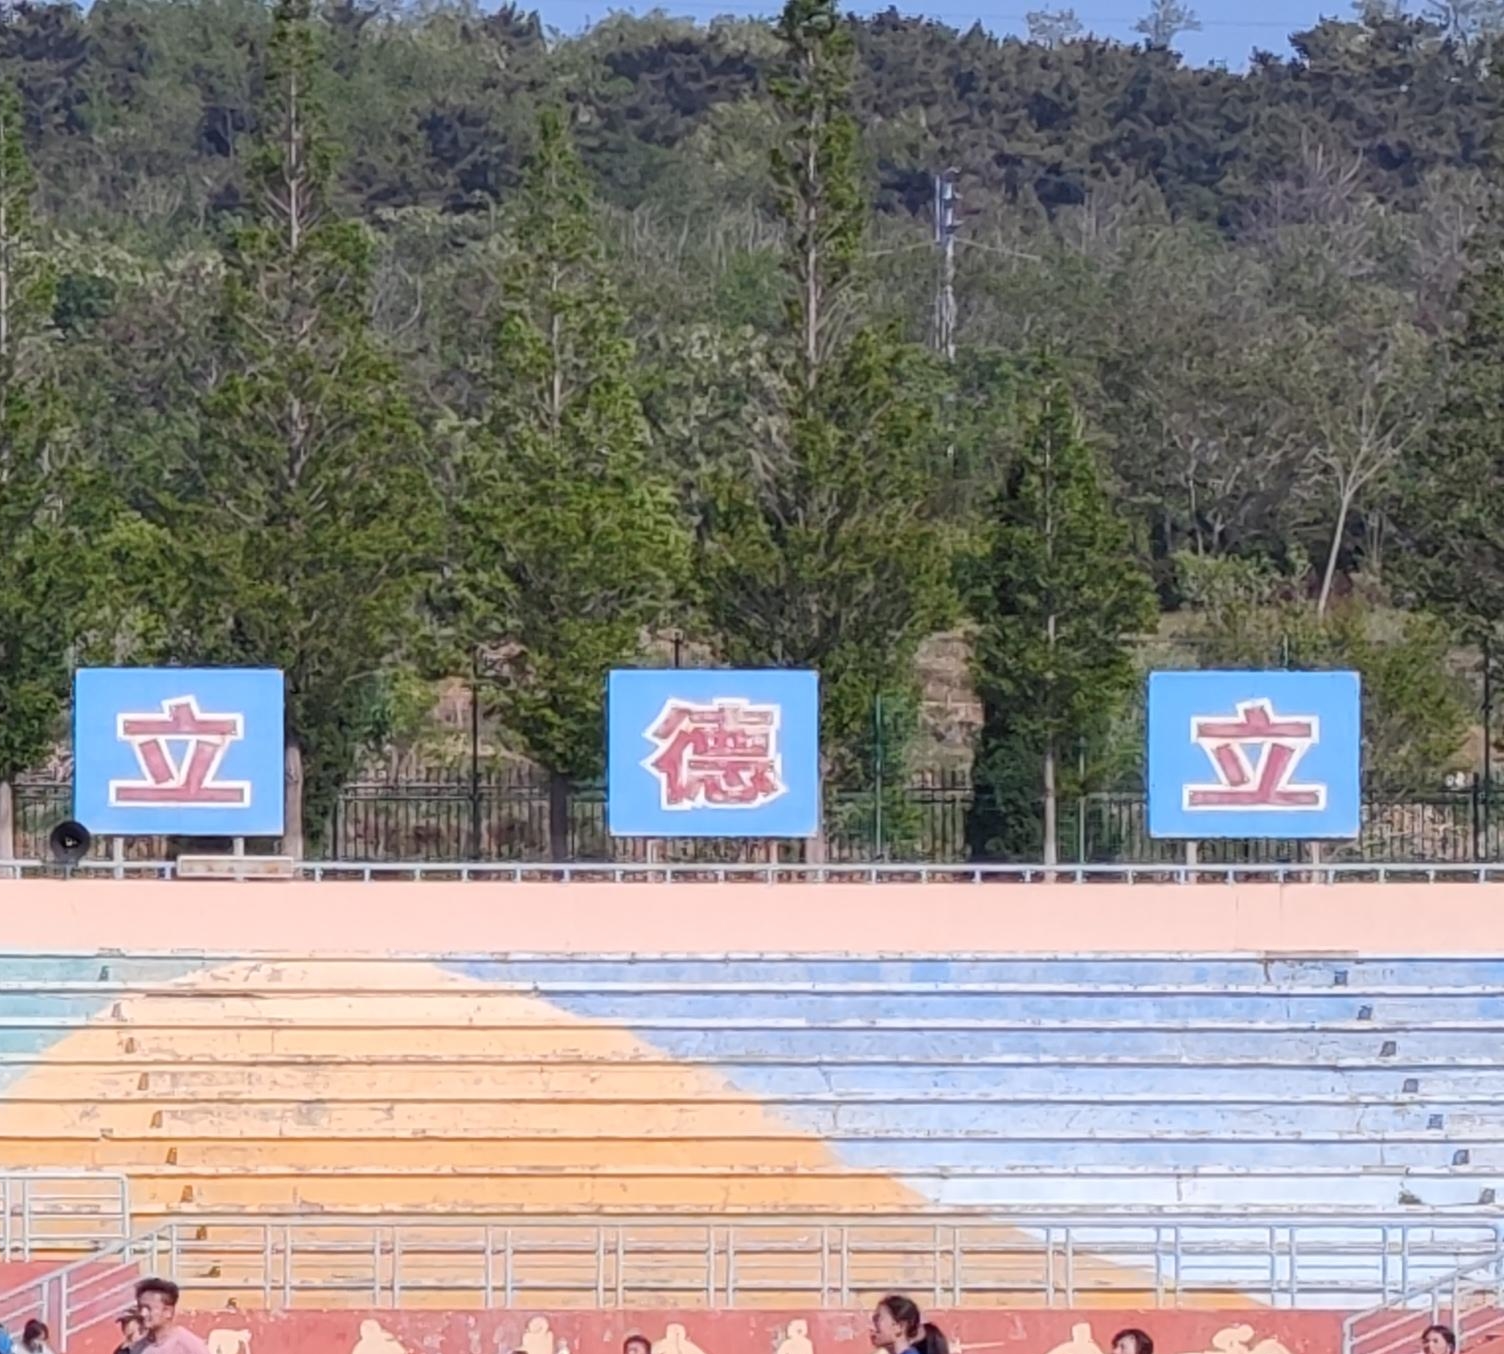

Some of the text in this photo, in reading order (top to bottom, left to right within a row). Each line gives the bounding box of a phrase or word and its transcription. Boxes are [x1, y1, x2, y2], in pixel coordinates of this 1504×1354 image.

[108, 696, 252, 807] 立
[640, 698, 789, 811] 德
[1182, 697, 1328, 812] 立
